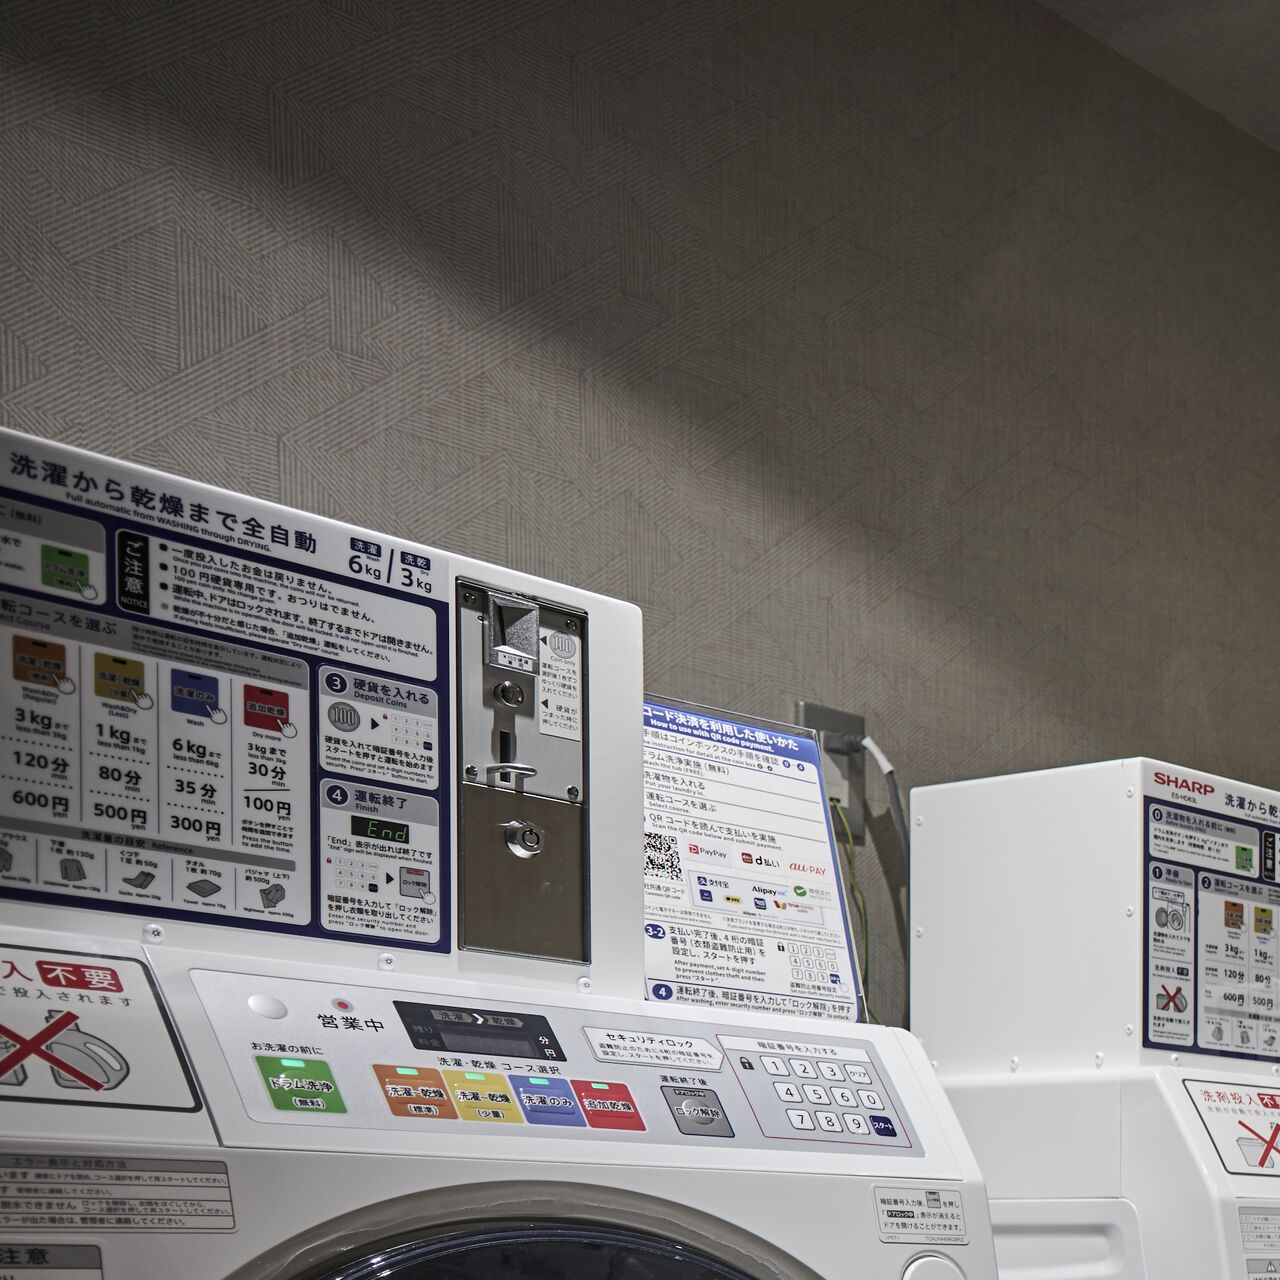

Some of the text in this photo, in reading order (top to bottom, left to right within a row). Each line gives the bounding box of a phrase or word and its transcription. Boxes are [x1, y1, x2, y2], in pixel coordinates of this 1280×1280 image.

[10, 450, 317, 555] 洗濯から乾燥まで全自動
[66, 491, 82, 502] Full
[86, 496, 131, 516] automatic
[133, 509, 155, 522] from
[157, 515, 199, 534] WASHING
[201, 526, 236, 543] through
[353, 539, 379, 556] 洗濯
[124, 540, 144, 595] ご注意
[120, 596, 149, 609] NOTICE
[332, 677, 429, 704] 3 硬貨を入れる
[354, 691, 407, 708] Deposit Coins
[651, 719, 667, 728] How
[679, 726, 692, 734] use
[694, 729, 709, 737] with
[711, 732, 722, 741] QR
[723, 736, 739, 745] code
[741, 740, 775, 753] payment.
[1154, 772, 1215, 795] SHARP
[332, 789, 408, 809] 4 運転終了
[646, 791, 717, 812] 運転コースを選ぶ
[648, 801, 668, 810] Select
[368, 821, 406, 840] End
[700, 847, 727, 860] PayPay
[646, 926, 664, 938] 3-2
[46, 965, 116, 990] 不要
[658, 987, 666, 997] 4
[676, 995, 690, 1003] After
[730, 1002, 750, 1011] security
[752, 1004, 771, 1012] number
[317, 1013, 385, 1034] 営業中
[250, 1041, 324, 1056] お洗濯の前に
[605, 1032, 694, 1049] セキュリティロック
[757, 1040, 837, 1056] 暗証番号を入力する
[502, 1063, 561, 1076] コース選択
[771, 1060, 779, 1072] 1
[800, 1064, 809, 1075] 2
[827, 1066, 837, 1077] 3
[269, 1077, 334, 1093] ドラム洗浄
[659, 1075, 708, 1087] 運転終了後
[522, 1093, 573, 1108] 洗濯のみ
[784, 1086, 876, 1105] 4 5 6 0
[585, 1099, 634, 1113] 追加乾燥
[675, 1106, 721, 1120] ロック解除
[796, 1113, 894, 1132] 7 8 9 スタート
